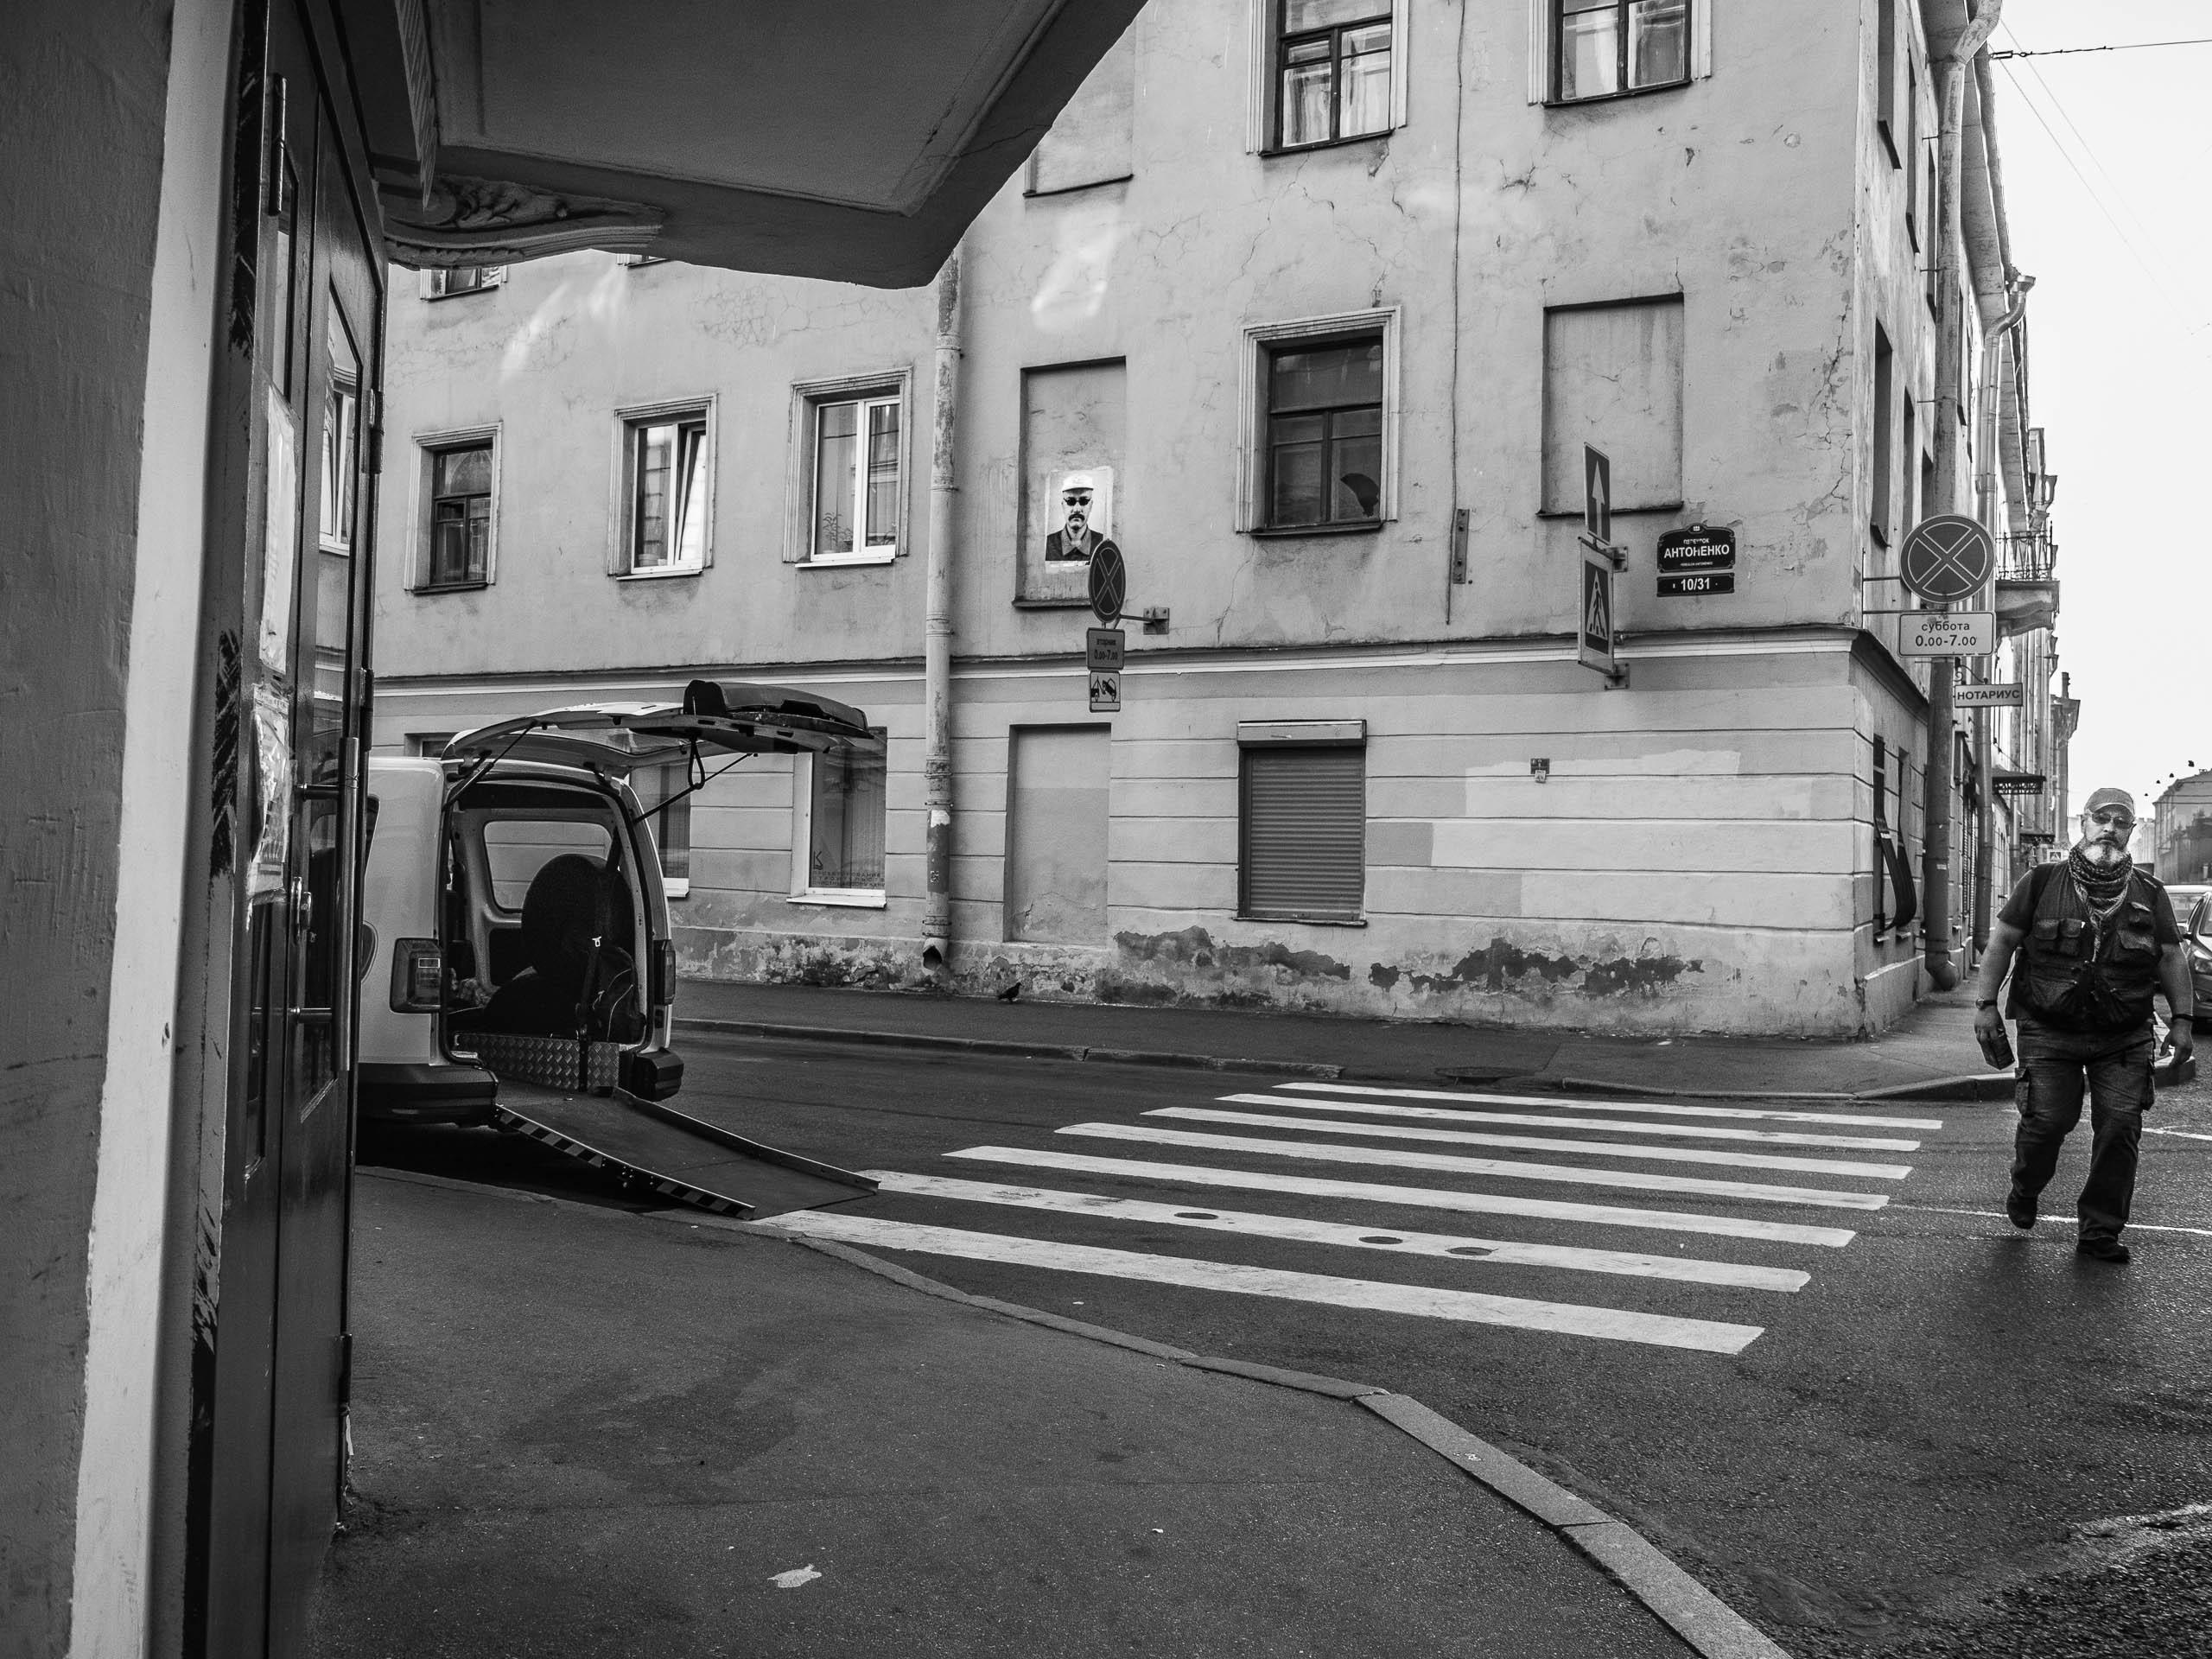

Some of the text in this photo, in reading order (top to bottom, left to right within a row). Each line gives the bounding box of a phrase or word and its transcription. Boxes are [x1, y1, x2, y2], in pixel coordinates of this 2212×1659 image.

[1663, 543, 1730, 559] АНТОНЕНКО
[1681, 577, 1711, 591] 10/31
[1921, 620, 1971, 633] суббота
[1915, 634, 1977, 647] 0.00-7.00
[1957, 690, 2020, 700] НОТАРИУС
